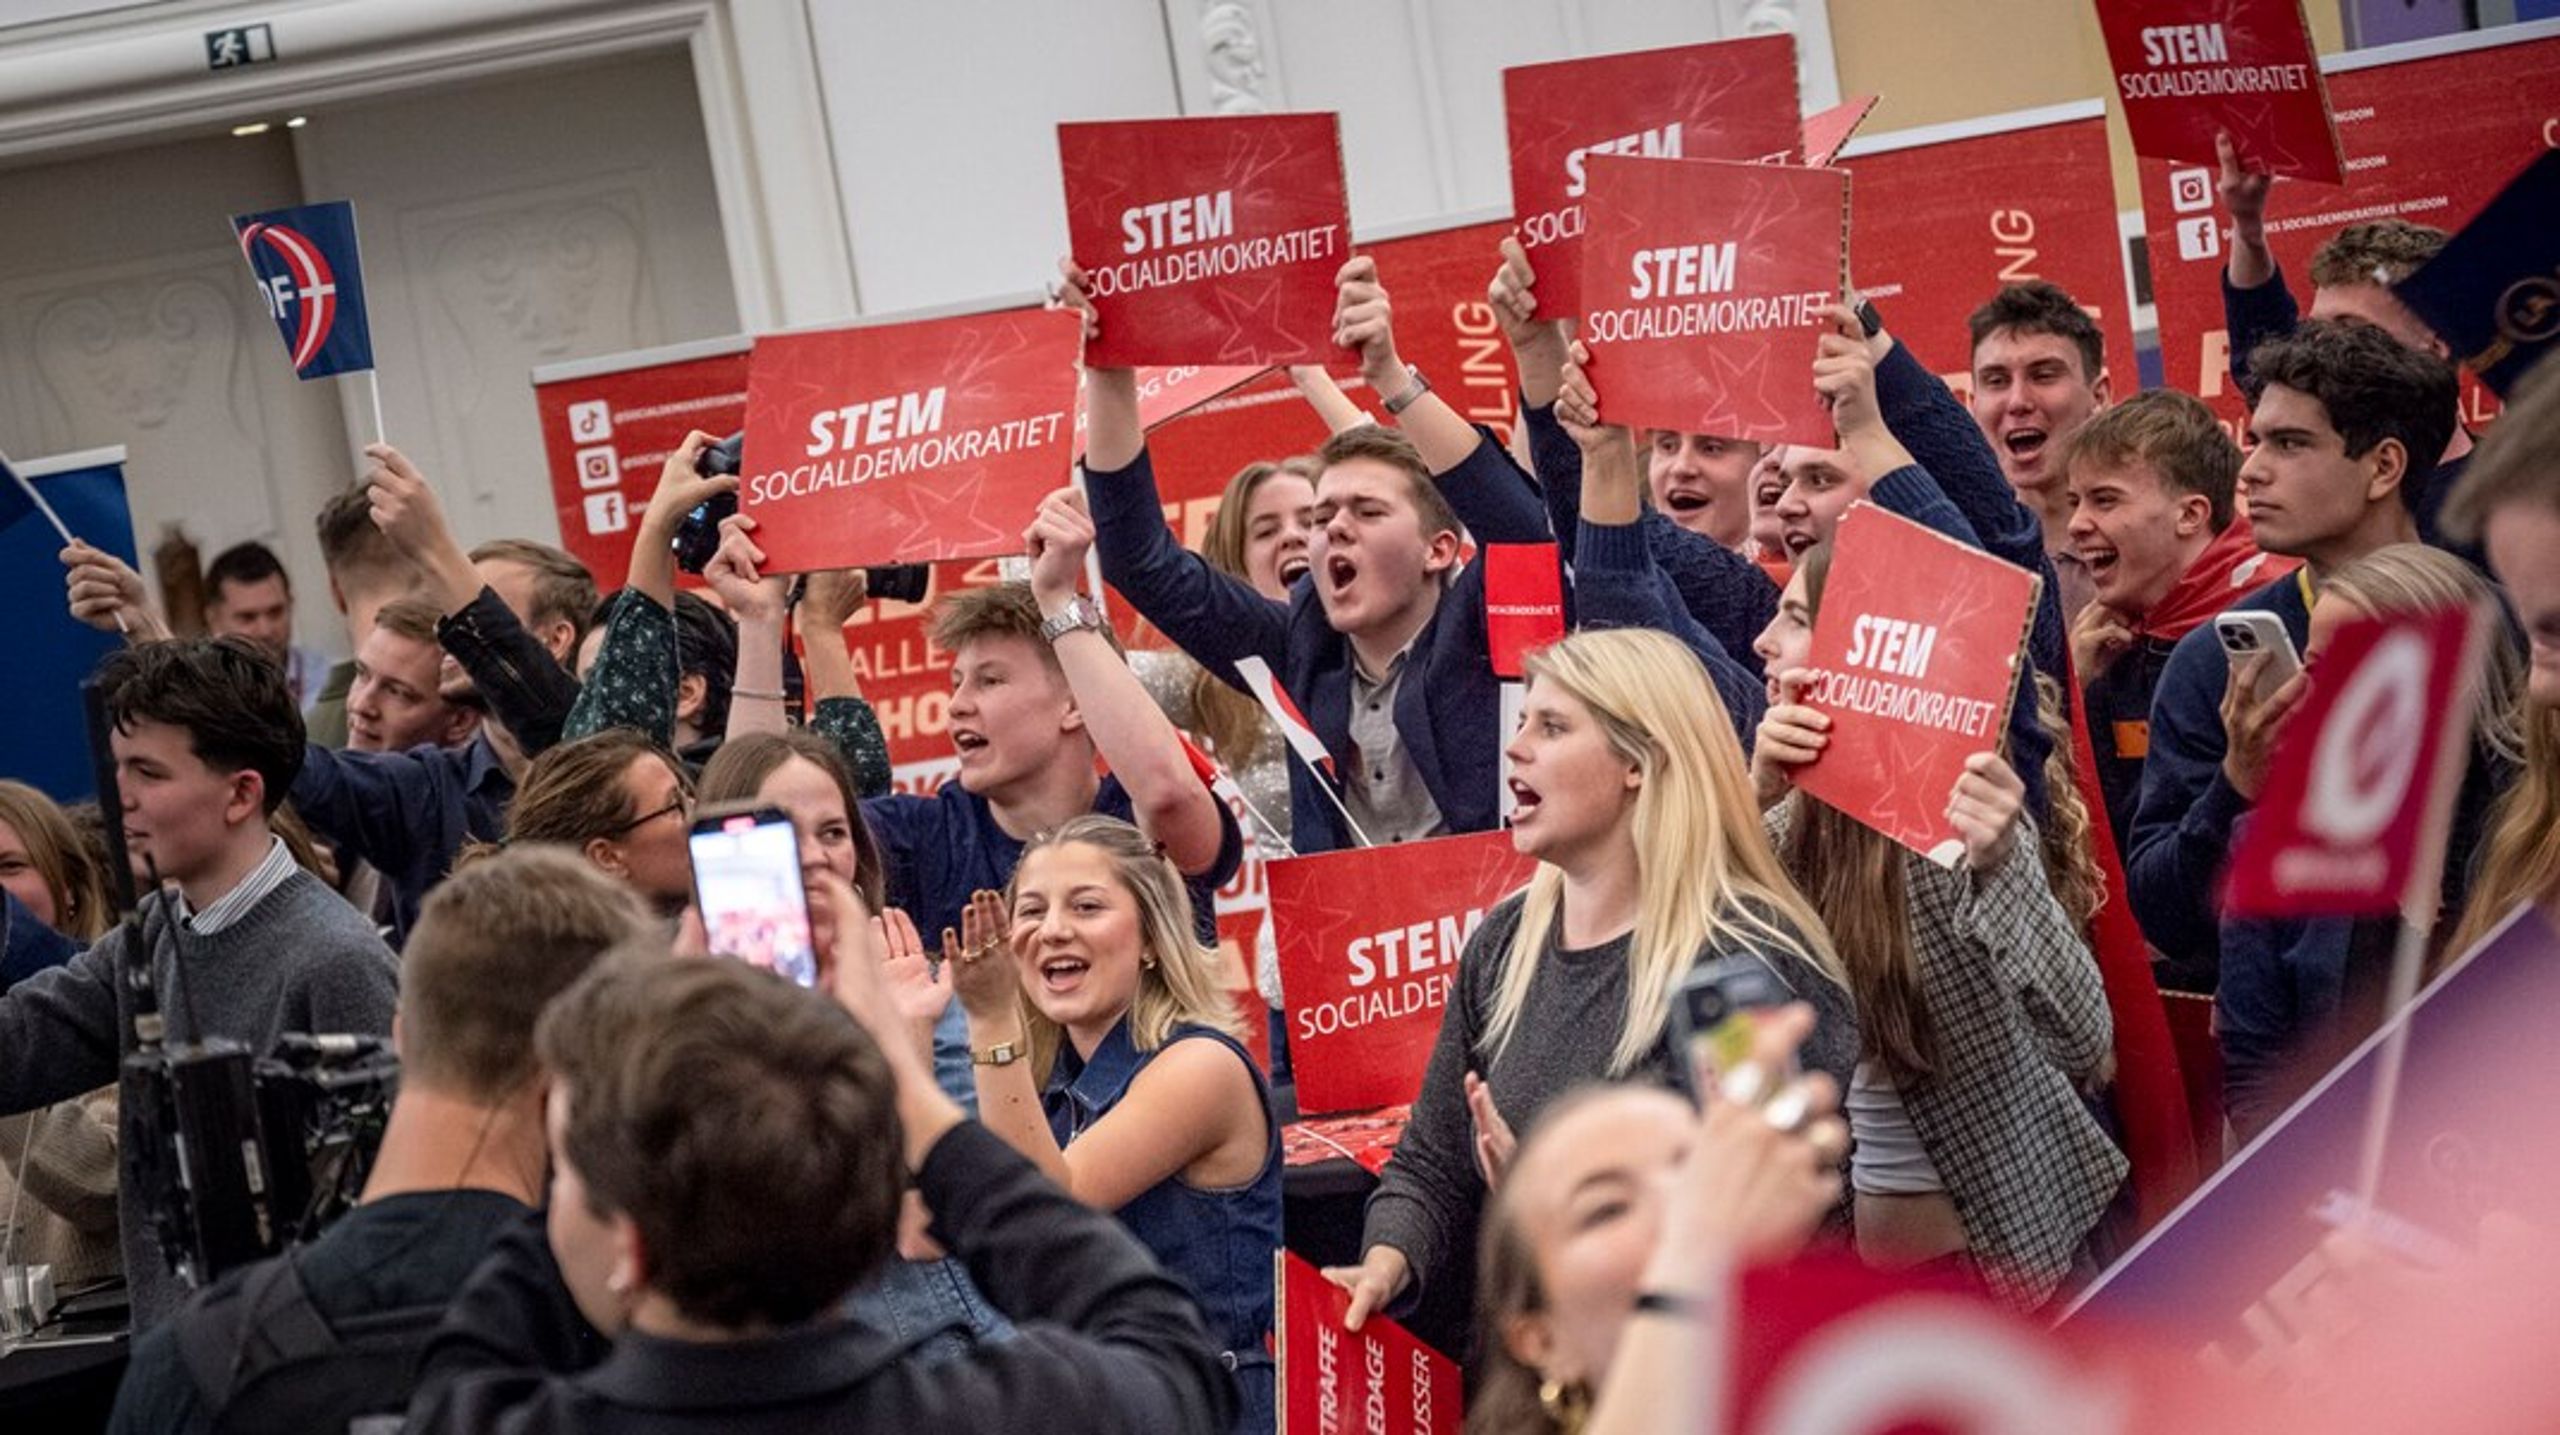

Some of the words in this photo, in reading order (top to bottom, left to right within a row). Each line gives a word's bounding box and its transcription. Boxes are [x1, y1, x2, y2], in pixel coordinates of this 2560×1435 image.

[2141, 23, 2228, 66] STEM
[2121, 64, 2307, 99] SOCIALDEMOKRATIET
[1565, 122, 1683, 198] SM
[1121, 190, 1234, 255] STEM
[1085, 225, 1338, 299] SOCIALDEMOKRATIET
[1630, 242, 1738, 299] STEM
[1588, 291, 1832, 343] SOCIALDEMOKRATIET
[806, 387, 946, 457] STEM
[748, 412, 1064, 505] SOCIALDEMOKRATIET
[1846, 613, 1937, 679] STEM
[1347, 908, 1484, 987] STEM
